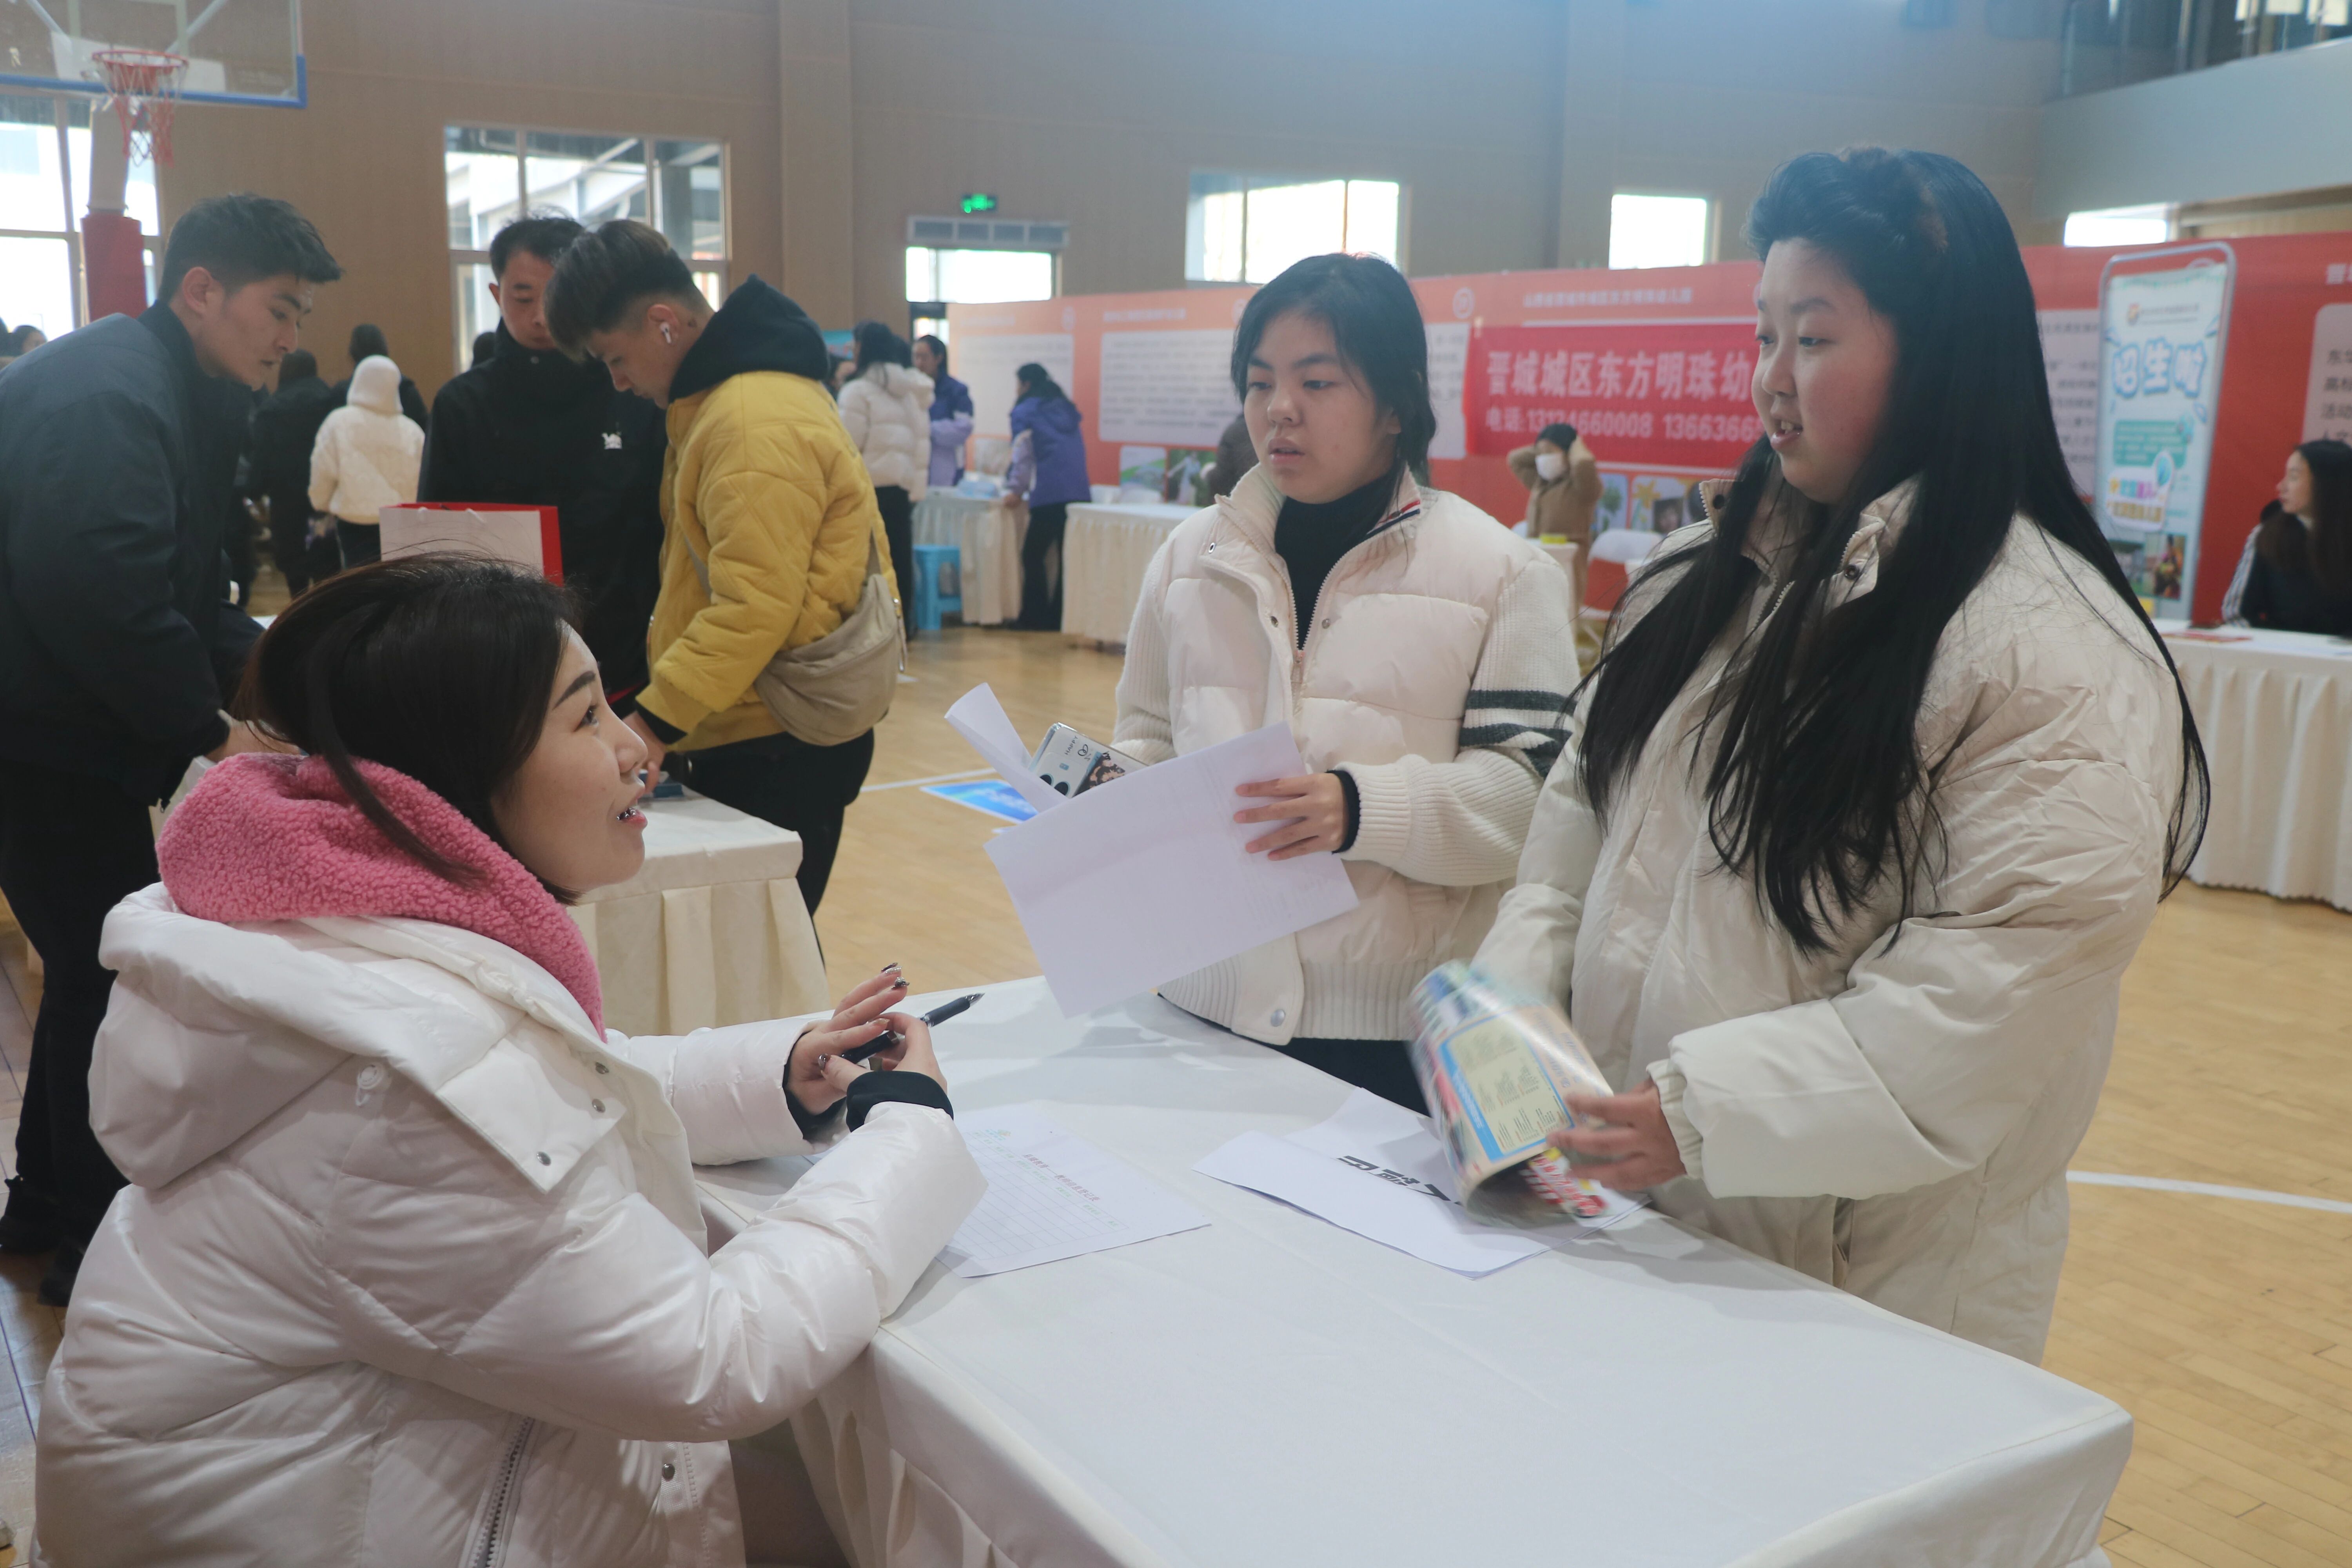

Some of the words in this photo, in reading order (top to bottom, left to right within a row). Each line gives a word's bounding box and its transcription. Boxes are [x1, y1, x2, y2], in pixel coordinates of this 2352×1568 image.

[1486, 350, 1752, 401] 晋城城区东方明珠幼
[1065, 735, 1078, 755] HAPPY
